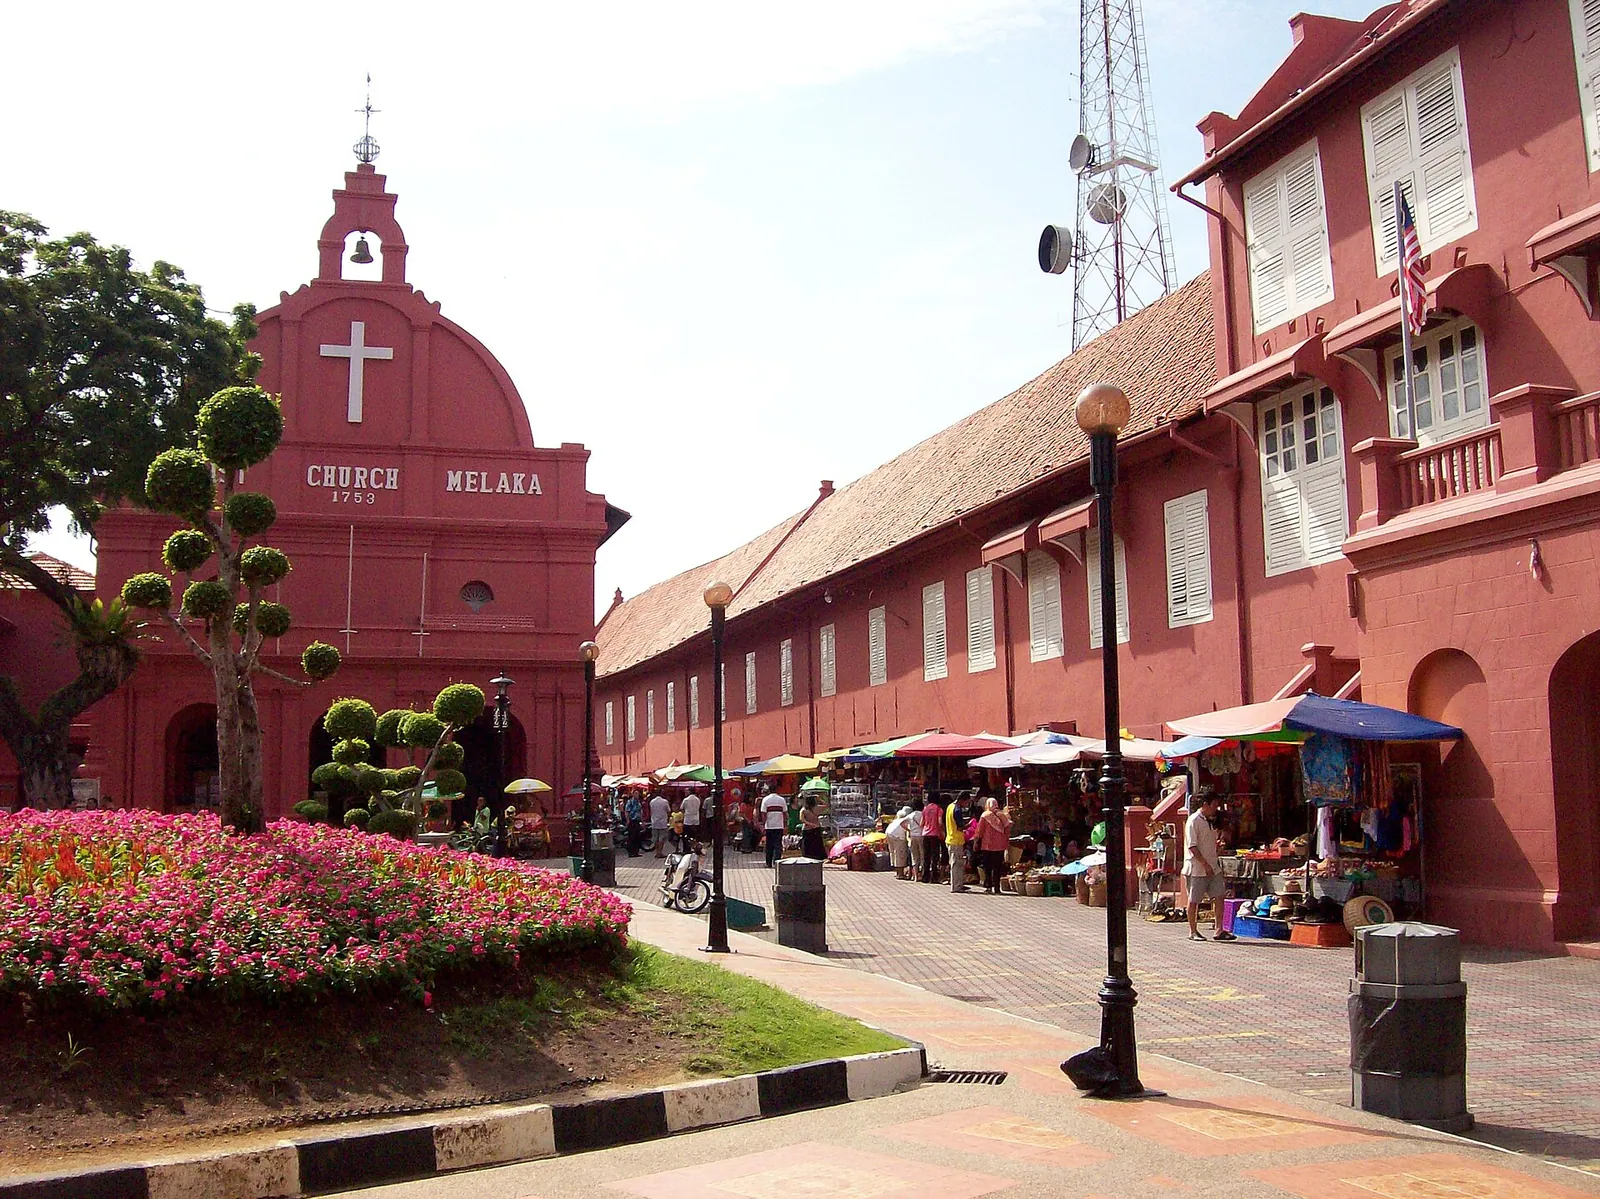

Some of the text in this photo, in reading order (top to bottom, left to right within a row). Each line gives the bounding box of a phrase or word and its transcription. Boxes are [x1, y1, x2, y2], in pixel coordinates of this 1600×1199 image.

[307, 465, 543, 495] CHURCH MELAKA
[332, 491, 376, 504] 1753
